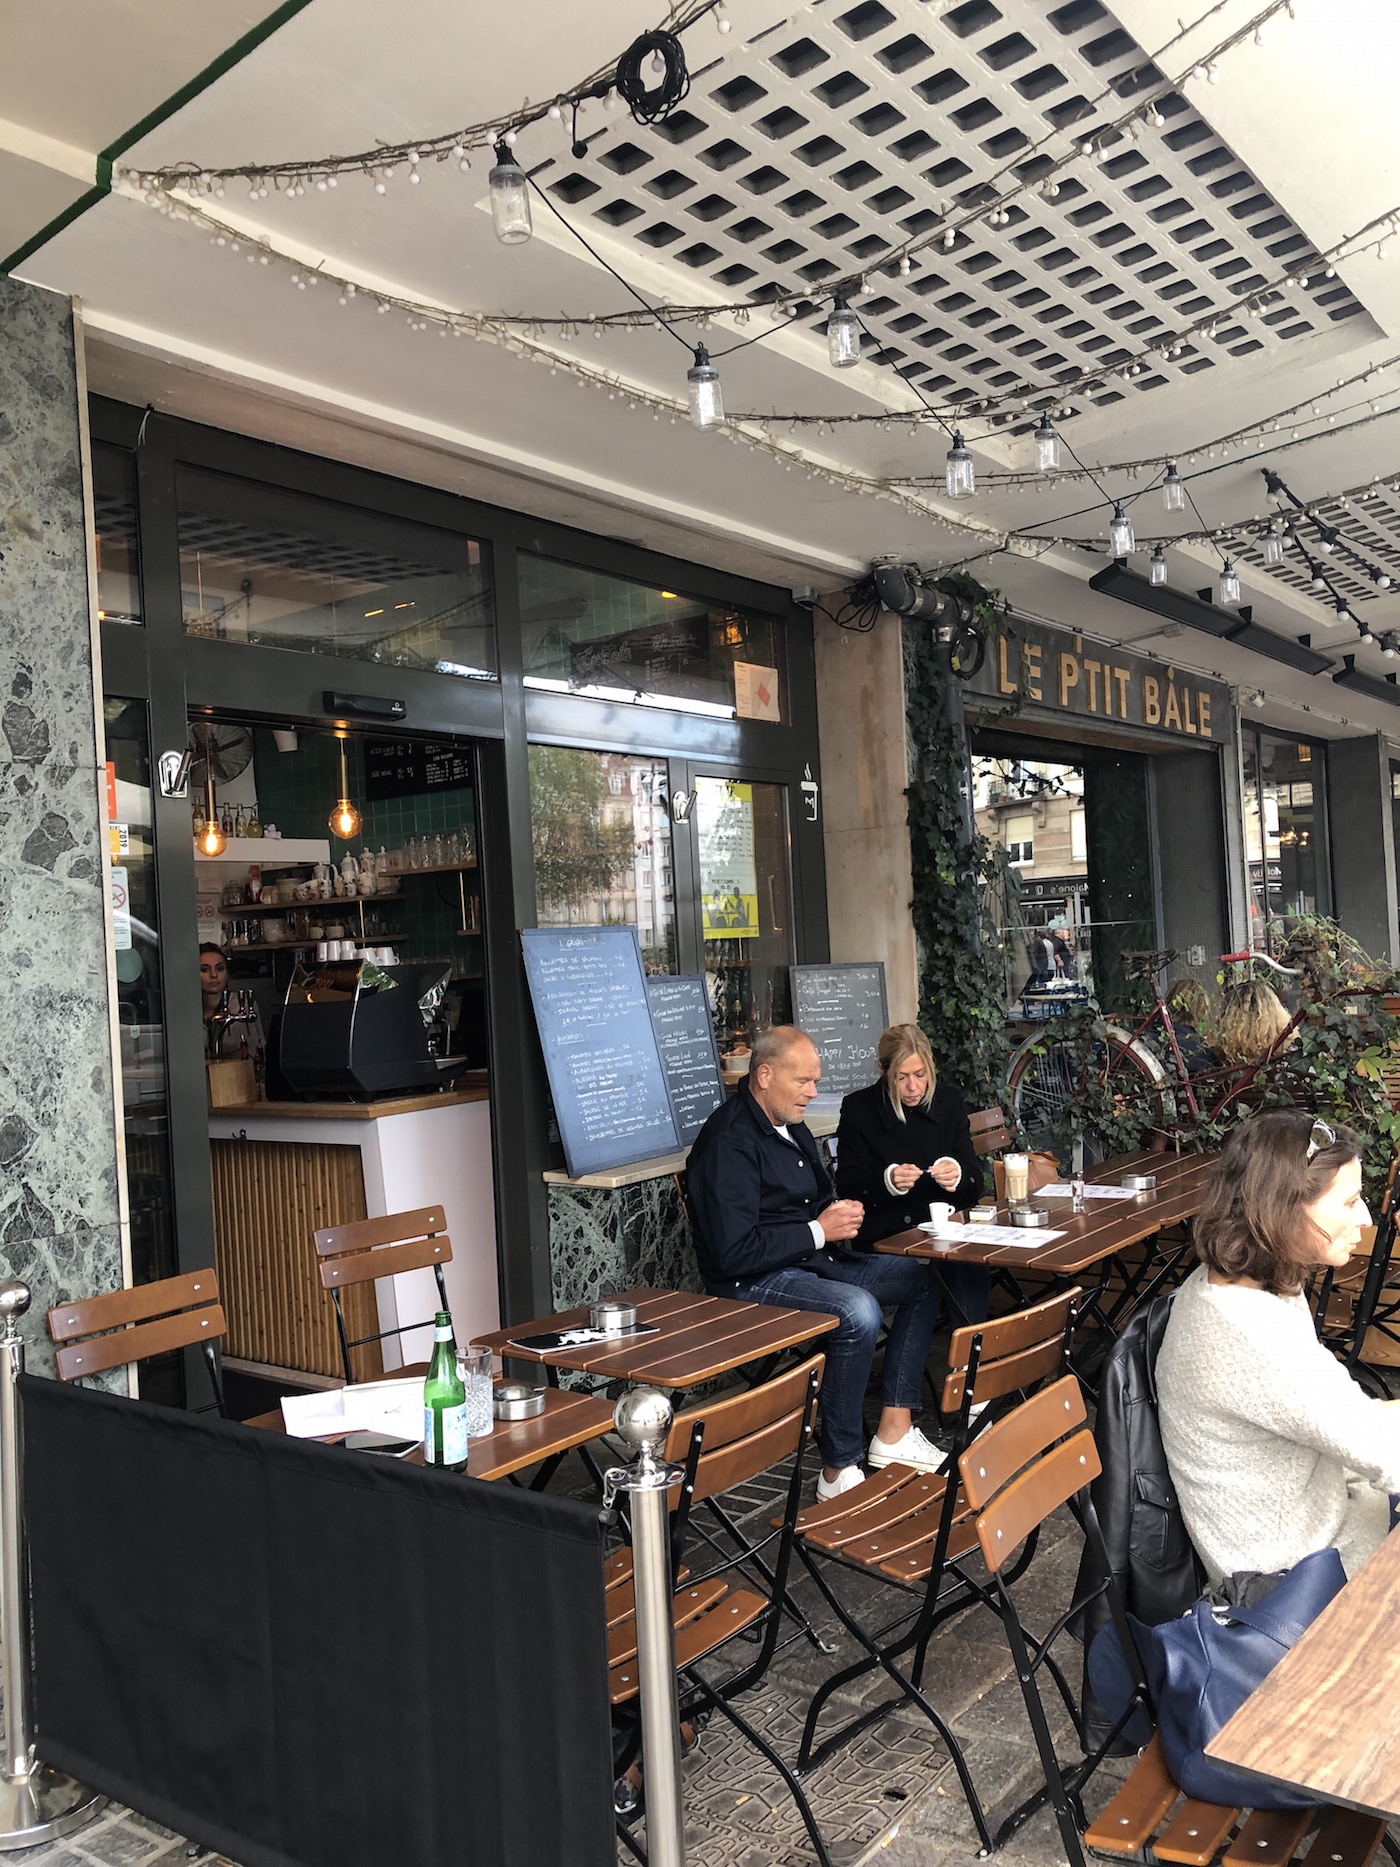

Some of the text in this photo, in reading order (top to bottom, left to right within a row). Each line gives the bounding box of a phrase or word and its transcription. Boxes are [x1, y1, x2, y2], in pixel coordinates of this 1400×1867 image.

[997, 634, 1043, 701] LE
[1058, 635, 1131, 719] P'TIT
[119, 829, 128, 848] 2019
[750, 1838, 780, 1853] 250
